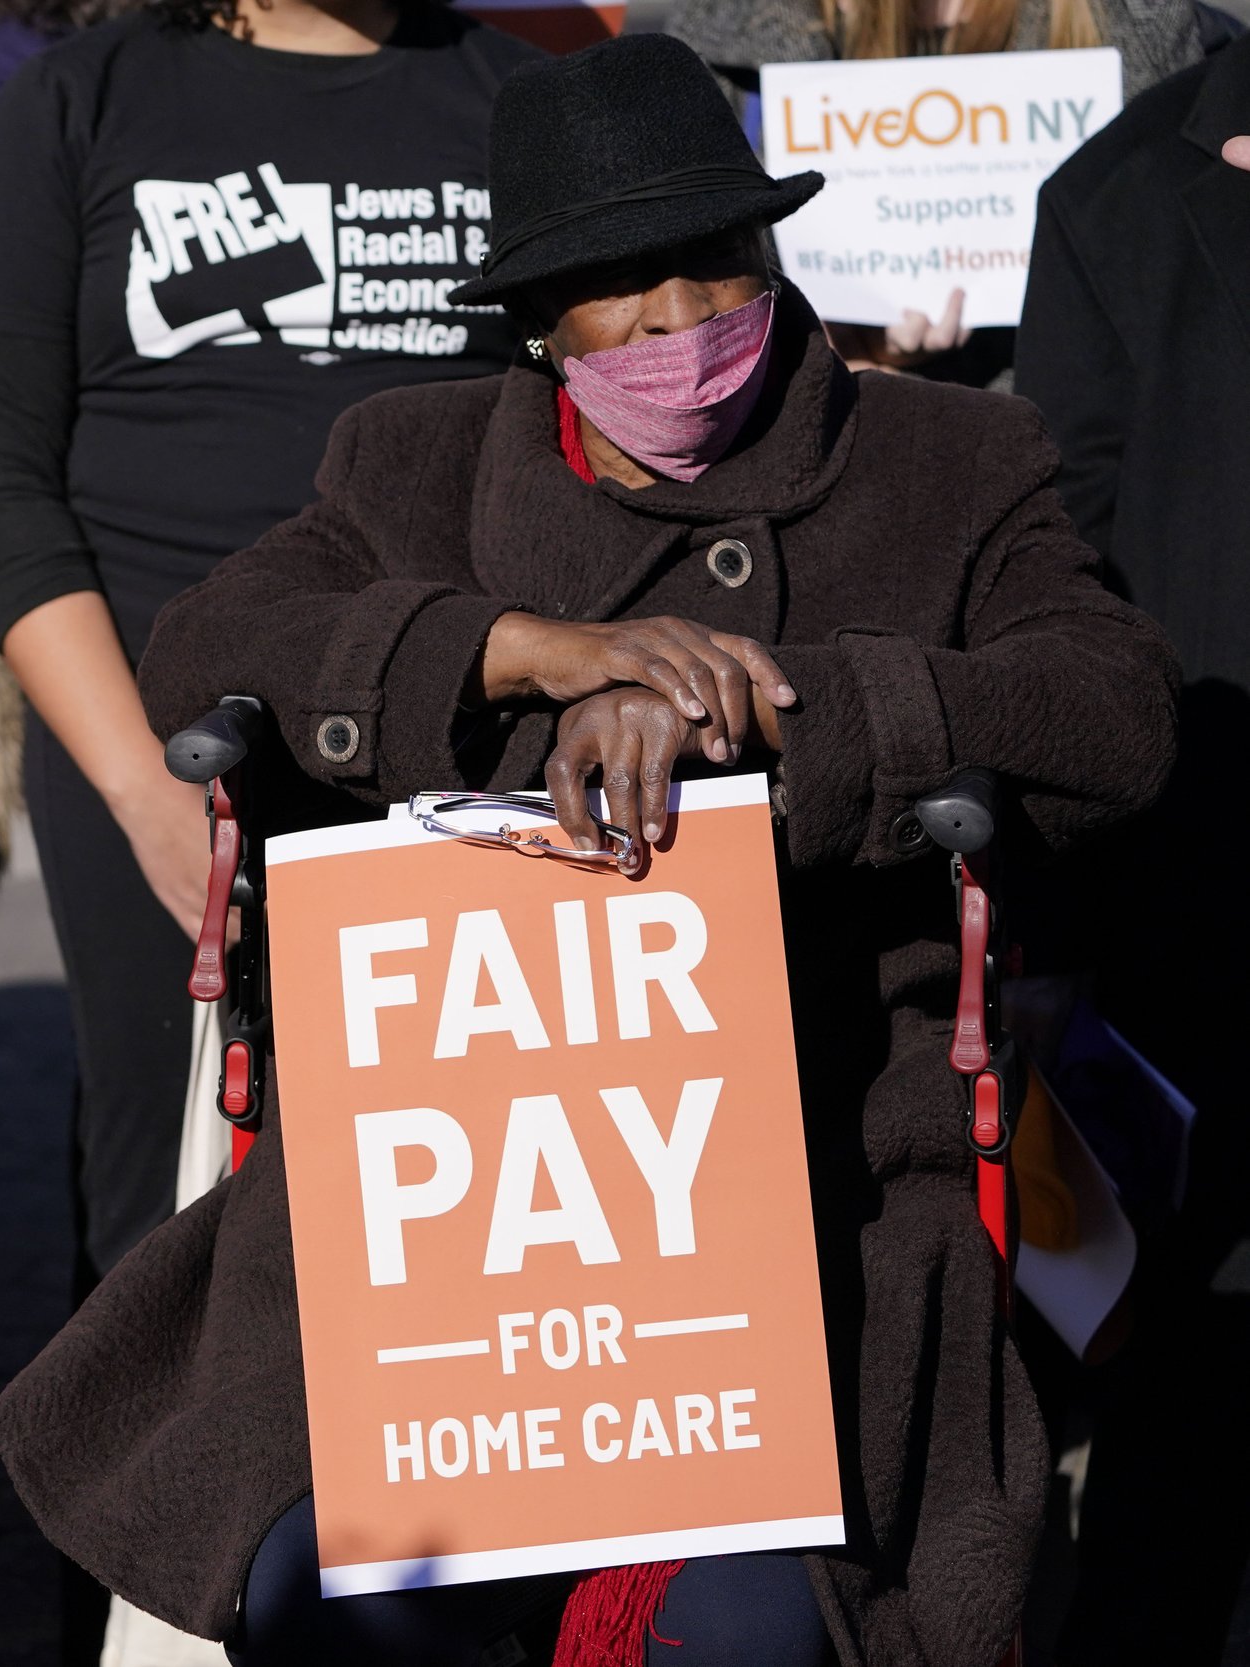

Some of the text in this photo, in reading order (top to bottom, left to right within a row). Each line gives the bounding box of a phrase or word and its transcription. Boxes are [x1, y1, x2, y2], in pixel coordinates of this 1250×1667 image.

[782, 88, 1095, 154] LiveOn NY
[334, 182, 437, 221] Jews
[875, 191, 1016, 225] Supports
[337, 224, 491, 266] Racial &
[332, 317, 469, 355] Justice
[336, 890, 720, 1070] FAIR
[352, 1076, 725, 1289] PAY
[496, 1303, 629, 1377] FOR
[382, 1387, 762, 1485] HOME CARE
